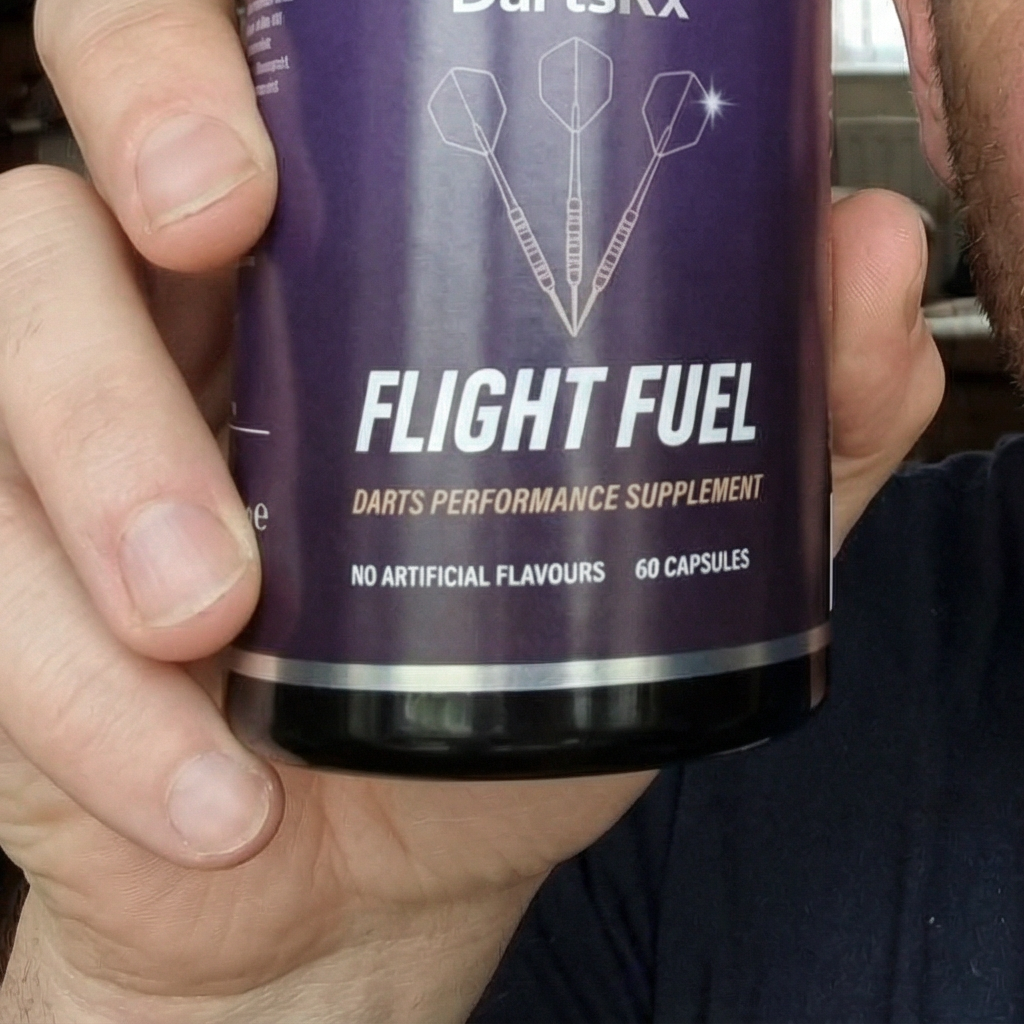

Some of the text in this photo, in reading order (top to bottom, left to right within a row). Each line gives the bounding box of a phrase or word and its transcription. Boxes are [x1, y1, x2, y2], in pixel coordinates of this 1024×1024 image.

[355, 362, 756, 453] FLIGHT FUEL
[352, 474, 764, 515] DARTS PERFORMANCE SUPPLEMENT
[351, 561, 606, 587] NO ARTIFICIAL FLAVOURS
[635, 548, 750, 580] 60 CAPSULES
